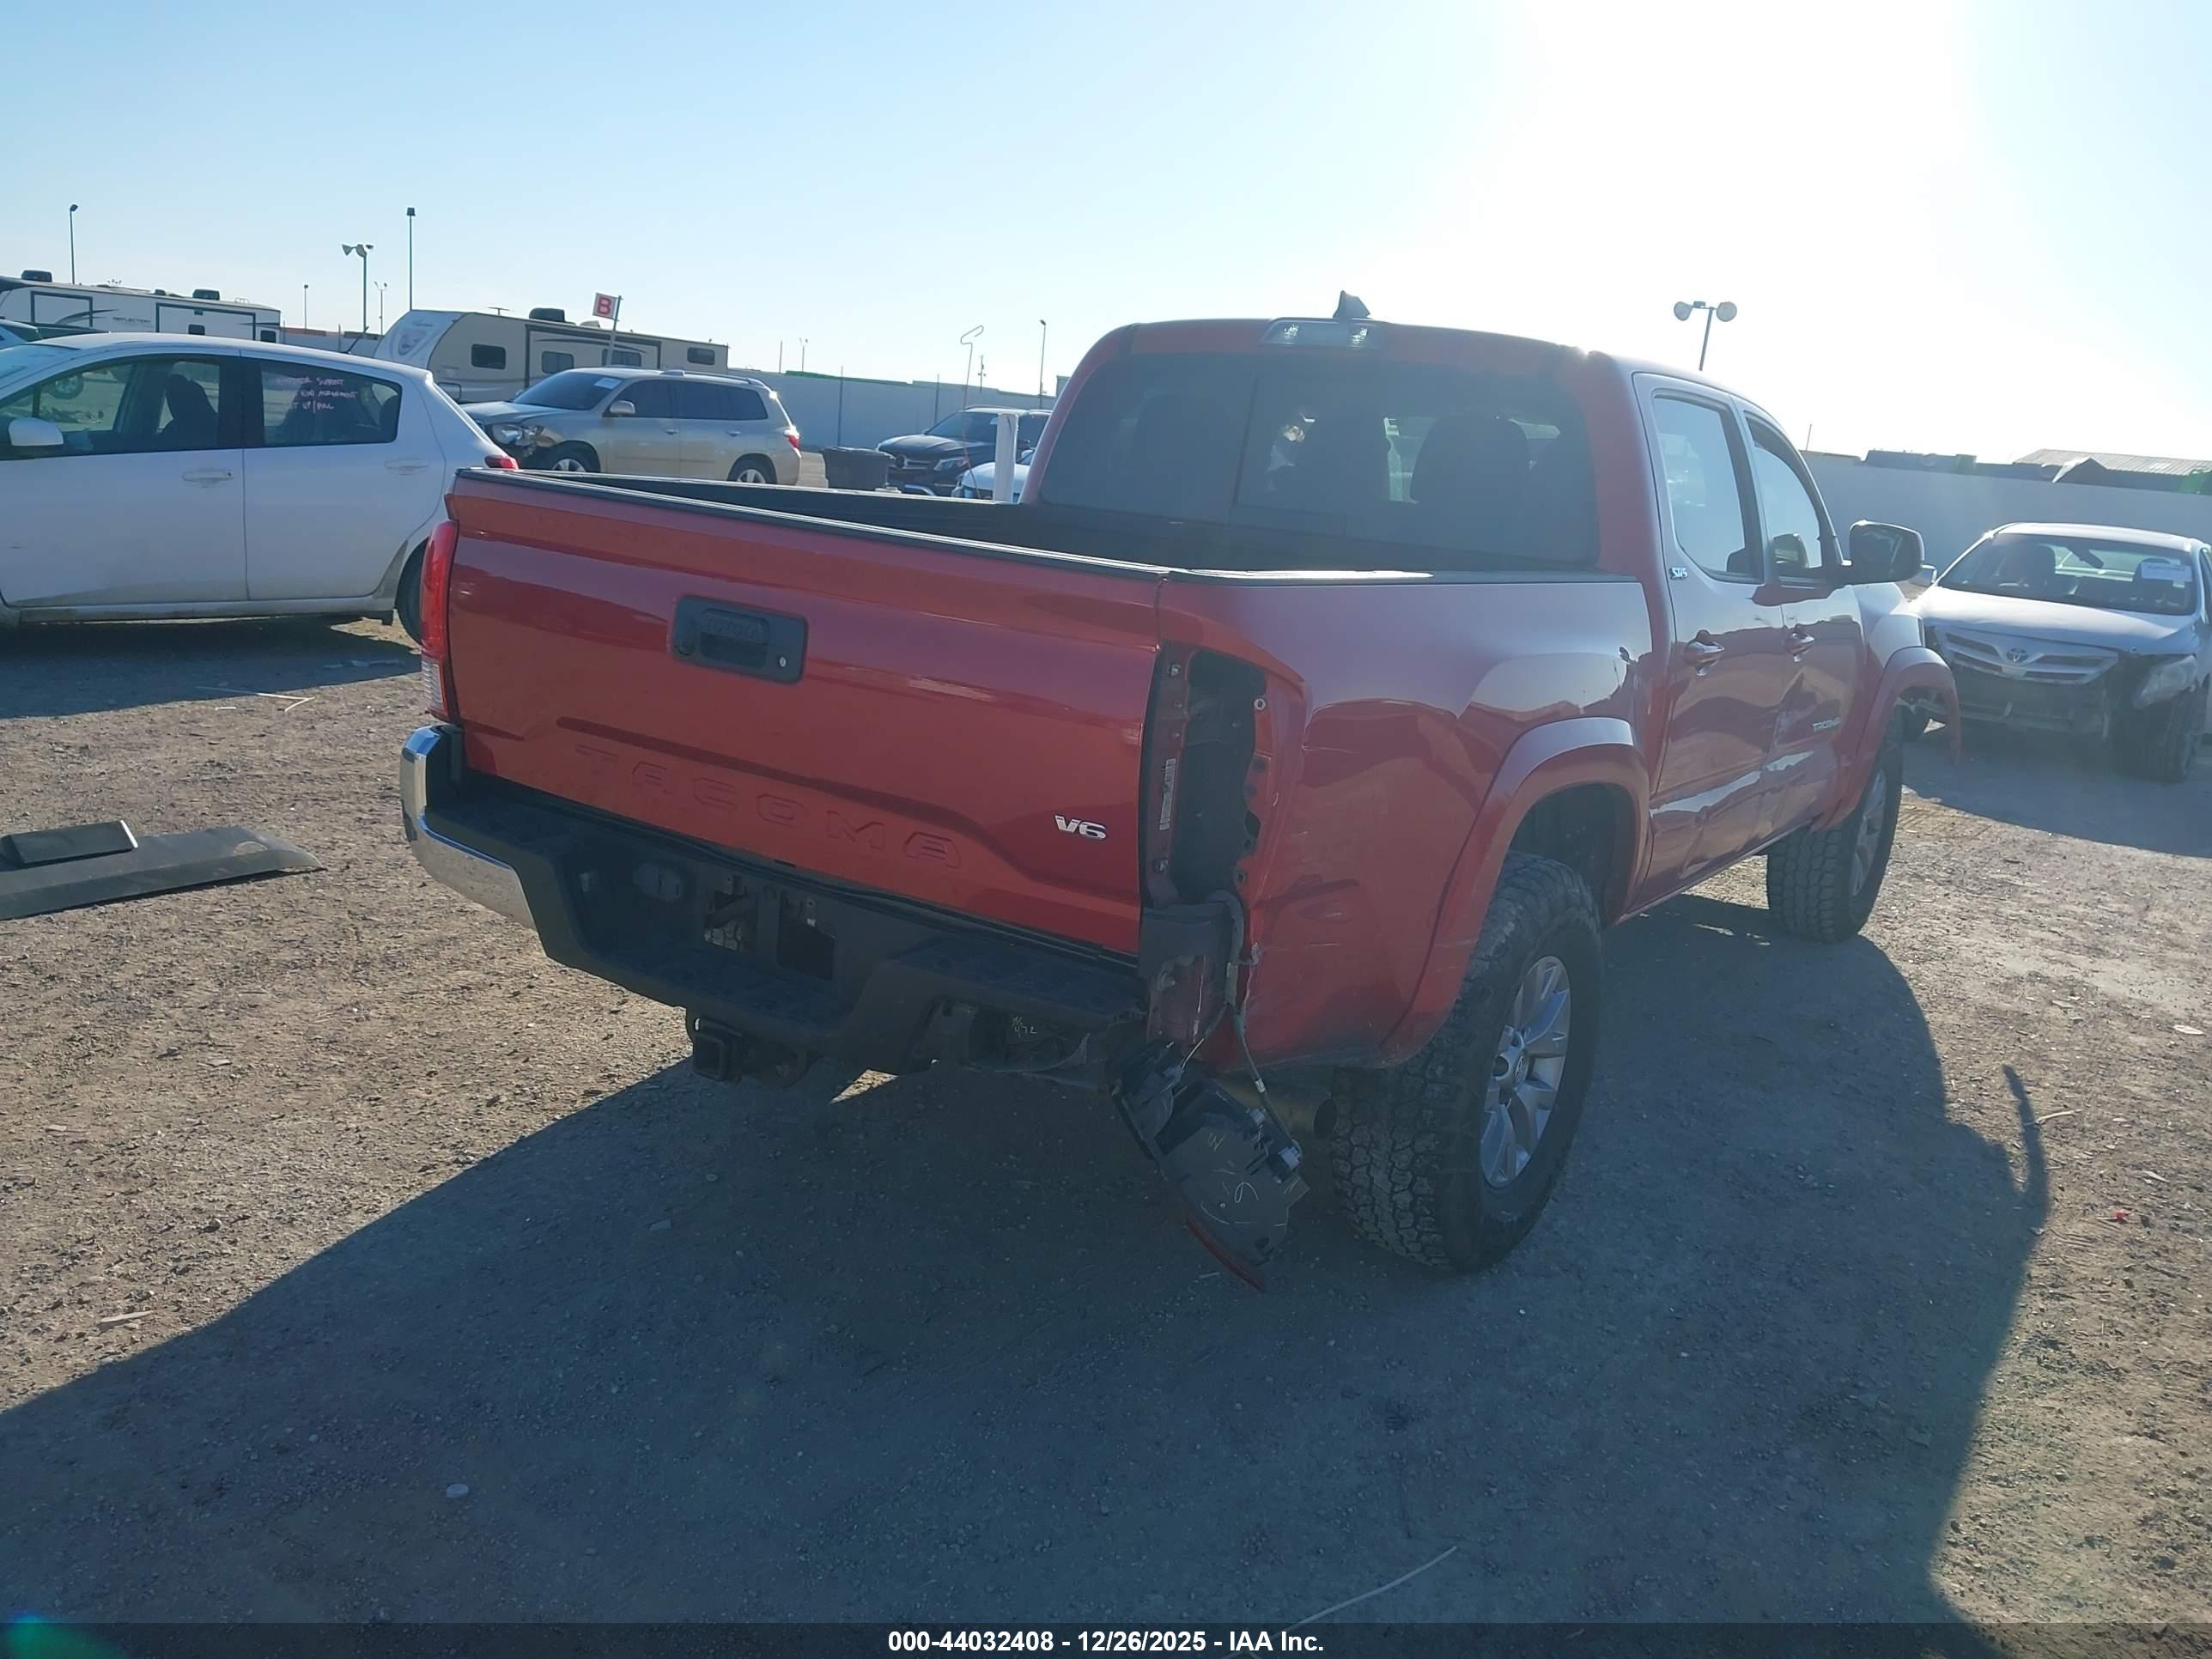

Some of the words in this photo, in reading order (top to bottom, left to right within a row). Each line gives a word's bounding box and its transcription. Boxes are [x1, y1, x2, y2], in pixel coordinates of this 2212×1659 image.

[597, 295, 611, 316] B
[574, 743, 962, 870] TACOMA
[1054, 814, 1106, 839] V6
